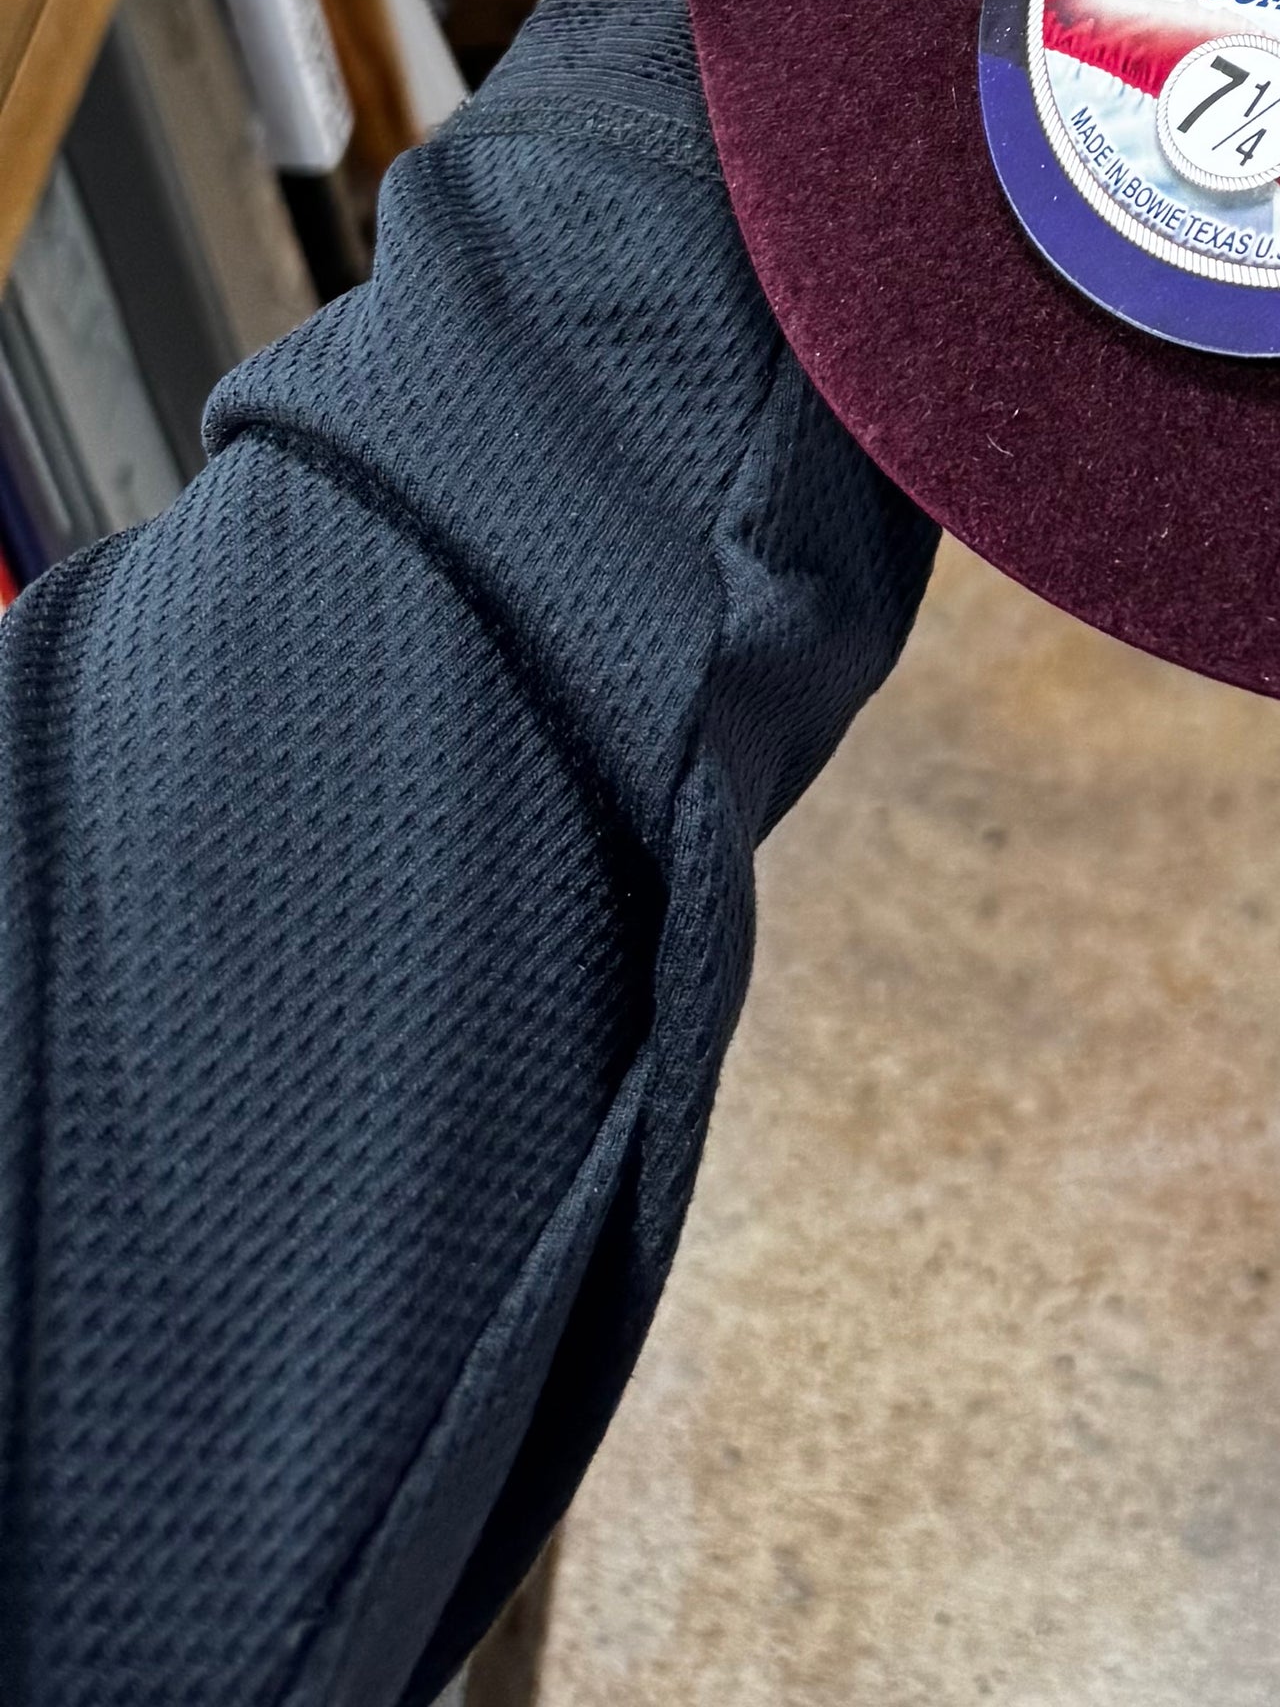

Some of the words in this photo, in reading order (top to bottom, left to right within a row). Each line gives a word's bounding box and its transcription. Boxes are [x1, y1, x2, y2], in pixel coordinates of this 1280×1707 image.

[1071, 106, 1114, 167] MADE
[1105, 157, 1131, 187] IN
[1122, 176, 1187, 232] BOWIE
[1183, 214, 1253, 255] TEXAS
